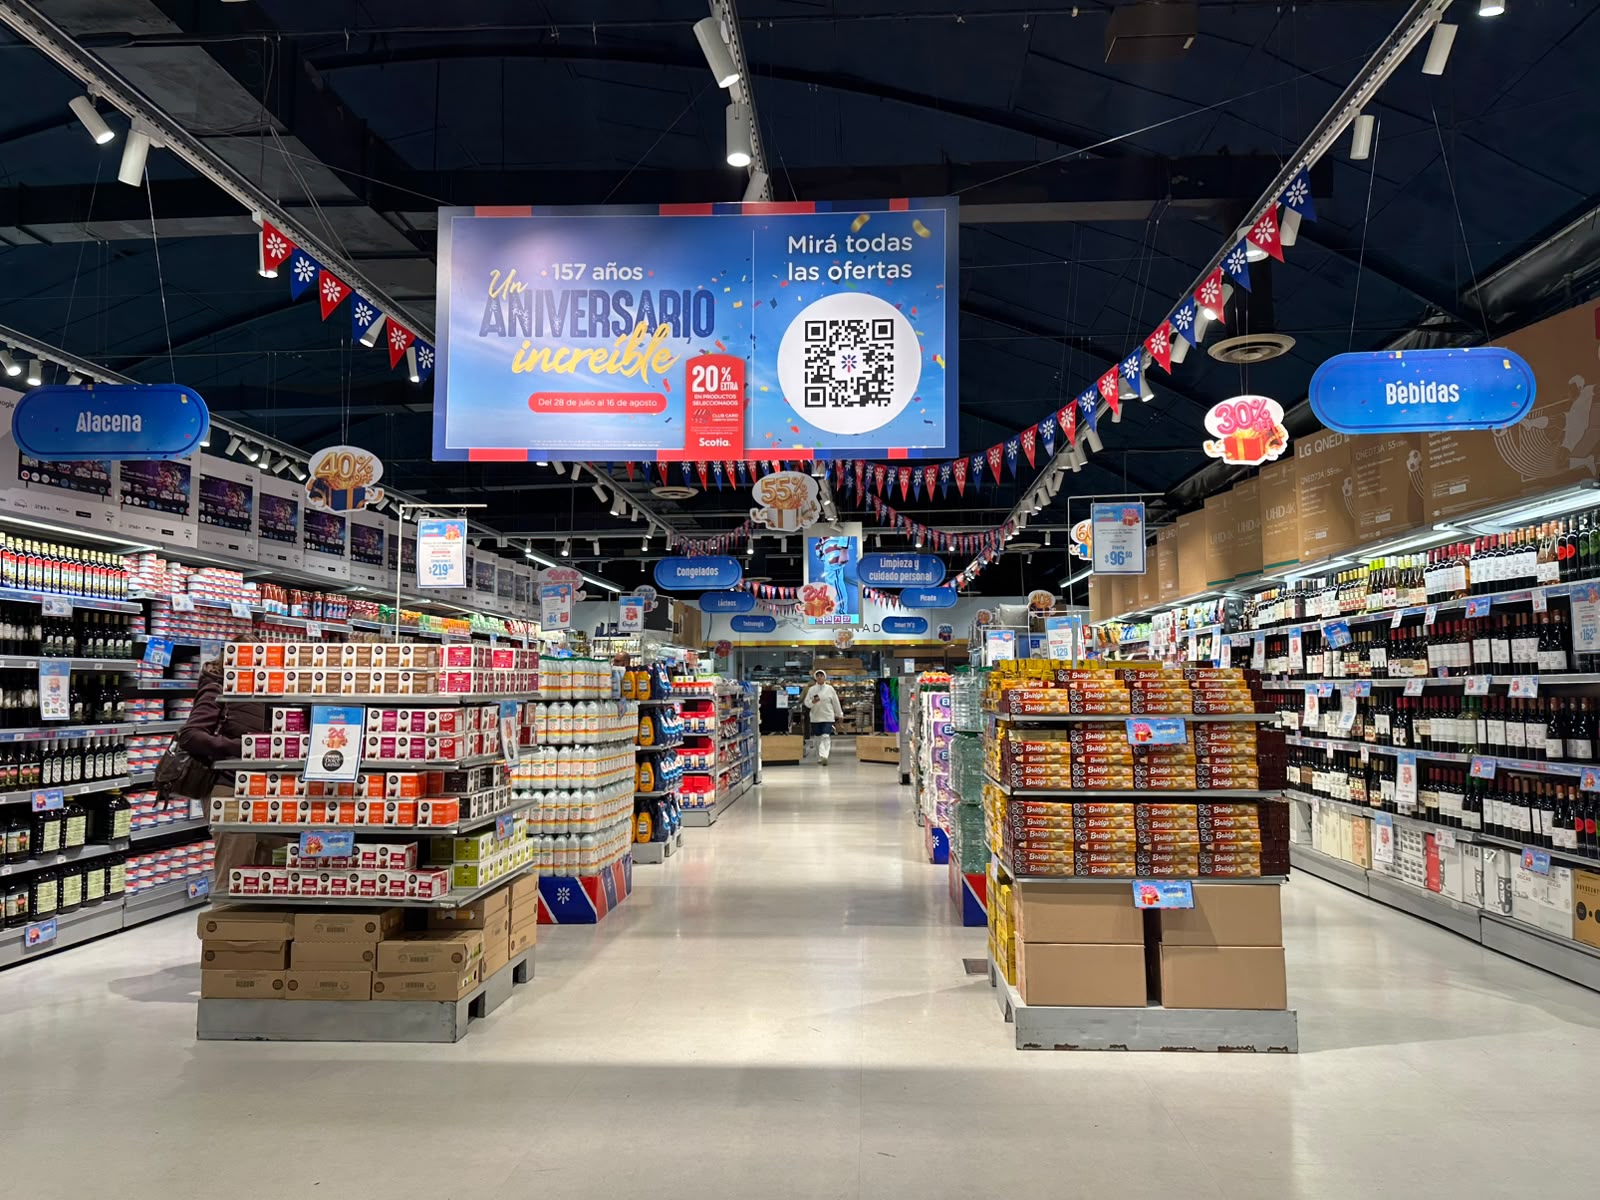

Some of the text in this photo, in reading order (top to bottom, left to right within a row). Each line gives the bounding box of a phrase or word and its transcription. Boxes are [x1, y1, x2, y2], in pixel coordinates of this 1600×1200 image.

[788, 233, 913, 254] Mirá todas
[552, 262, 643, 281] 157 años
[788, 261, 912, 281] las ofertas
[488, 269, 528, 300] Un
[479, 289, 715, 339] ANIVERSARIO
[511, 321, 681, 385] increíble
[720, 381, 738, 391] EXTRA
[1385, 382, 1460, 405] Bebidas
[538, 398, 657, 409] Del 28 de julio al 16 de agosto
[1215, 399, 1270, 434] 30%
[76, 411, 142, 433] Alacena
[1299, 443, 1312, 458] LG
[314, 451, 374, 479] 40%
[761, 476, 807, 504] 55%
[880, 558, 920, 570] Limpieza y
[677, 567, 719, 579] Congelados
[869, 571, 933, 584] cuidado personal
[1072, 671, 1091, 680] Bridge
[1139, 671, 1159, 679] Bridge
[1199, 670, 1219, 679] Bridge
[1023, 691, 1044, 699] Bridge
[1086, 691, 1105, 699] Bridge
[1147, 691, 1168, 700] Bridge
[1206, 691, 1227, 700] Bridge
[1025, 704, 1045, 712] Bridge
[1086, 703, 1106, 712] Bridge
[1147, 703, 1168, 711] Bridge
[1209, 703, 1230, 711] Bridge
[1086, 732, 1106, 740] Bridge
[1211, 732, 1231, 740] Bridge
[1026, 744, 1046, 752] Bridge
[1087, 744, 1107, 752] Bridge
[1211, 746, 1231, 754] Bridge
[1026, 765, 1046, 774] Bridge
[1088, 765, 1108, 774] Bridge
[1150, 766, 1171, 774] Bridge
[1212, 766, 1232, 774] Bridge
[1026, 777, 1046, 786] Bridge
[1088, 777, 1108, 786] Bridge
[1151, 779, 1171, 787] Bridge
[1213, 778, 1233, 786] Bridge
[1088, 805, 1109, 814] Bridge
[1152, 808, 1172, 816] Bridge
[1213, 806, 1233, 814] Bridge
[1027, 818, 1047, 826] Bridge
[1089, 819, 1109, 827] Bridge
[1152, 821, 1173, 829] Bridge
[1214, 818, 1234, 827] Bridge
[1030, 830, 1049, 838] Bridge
[1090, 831, 1111, 839] Bridge
[1154, 833, 1174, 841] Bridge
[1216, 831, 1236, 839] Bridge
[1029, 853, 1049, 861] Bridge
[1090, 853, 1111, 861] Bridge
[1091, 866, 1111, 874] Bridge
[1153, 866, 1173, 874] Bridge
[1215, 864, 1236, 873] Bridge
